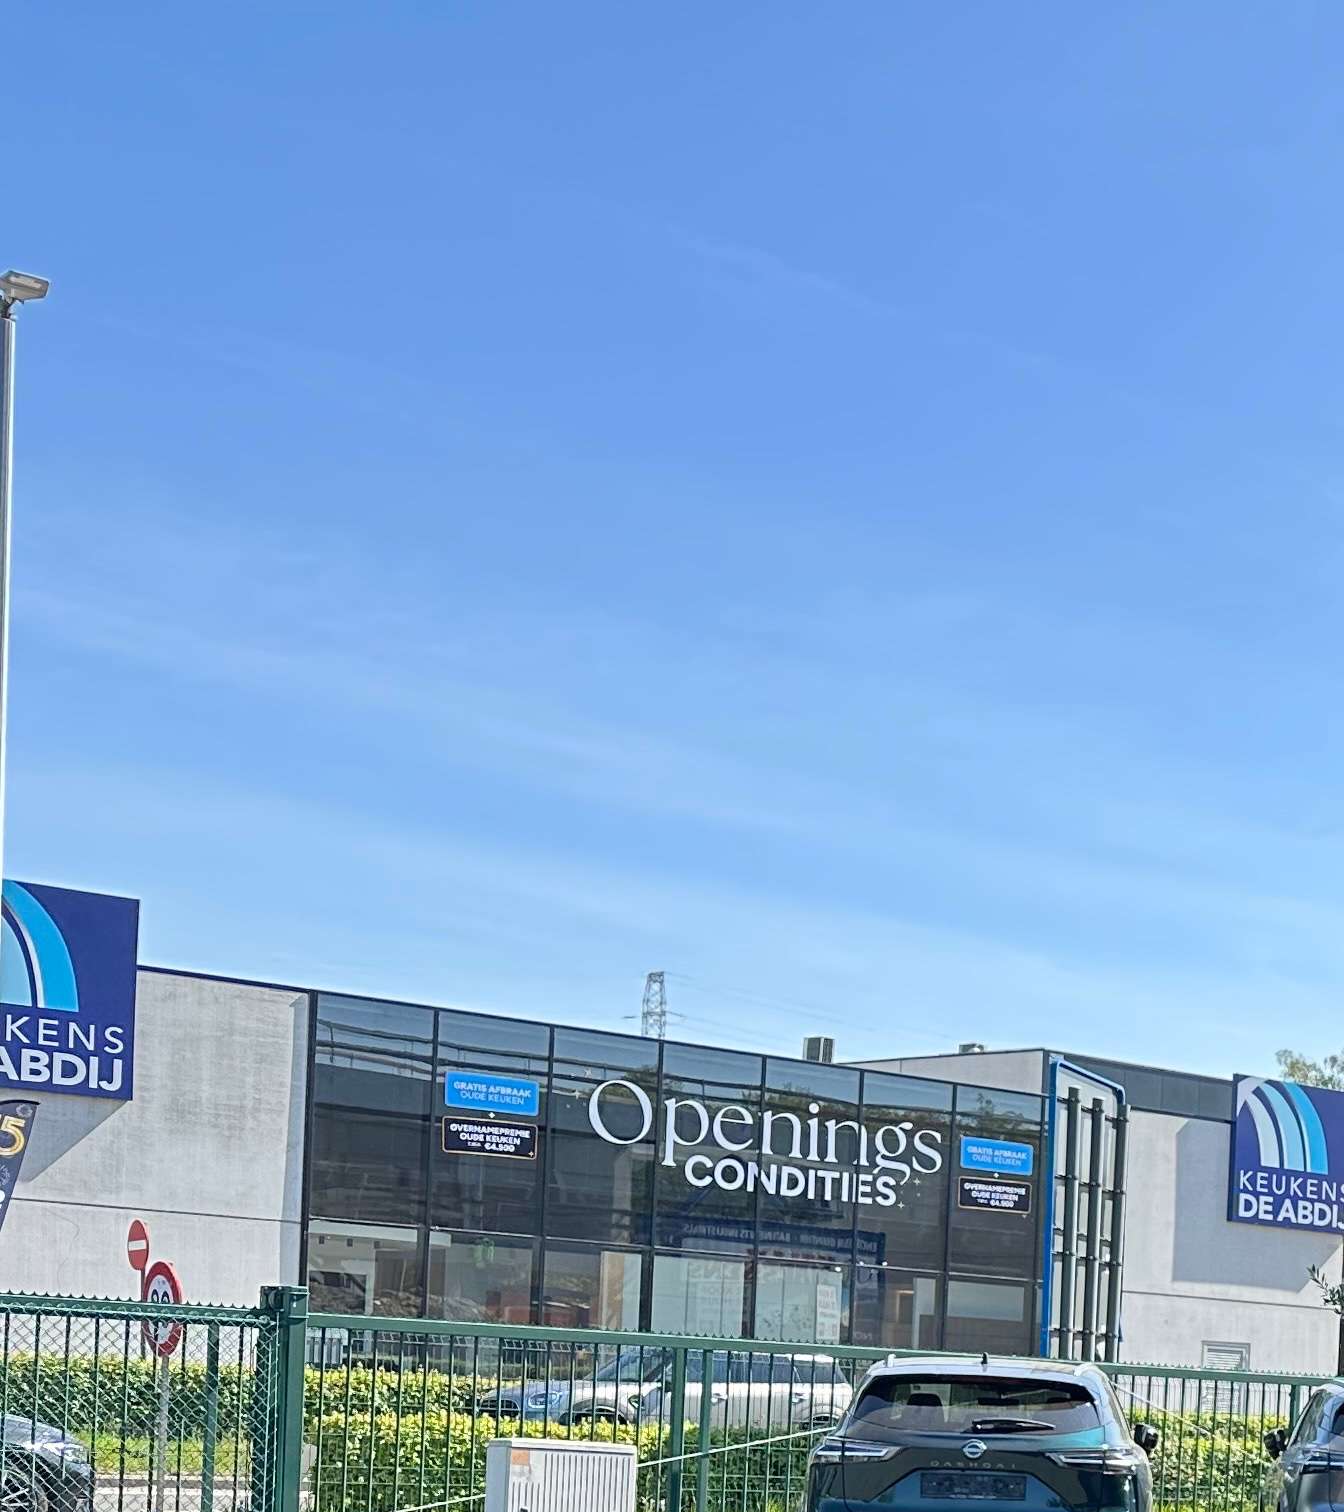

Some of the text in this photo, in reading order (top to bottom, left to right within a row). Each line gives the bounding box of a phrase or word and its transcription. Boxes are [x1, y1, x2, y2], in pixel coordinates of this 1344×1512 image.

[453, 1081, 532, 1098] GRATIS AFBRAAK
[460, 1090, 525, 1105] OUDE KEUKEN
[588, 1079, 944, 1188] Openings
[685, 1155, 898, 1207] CONDITIES
[1238, 1193, 1274, 1221] DE
